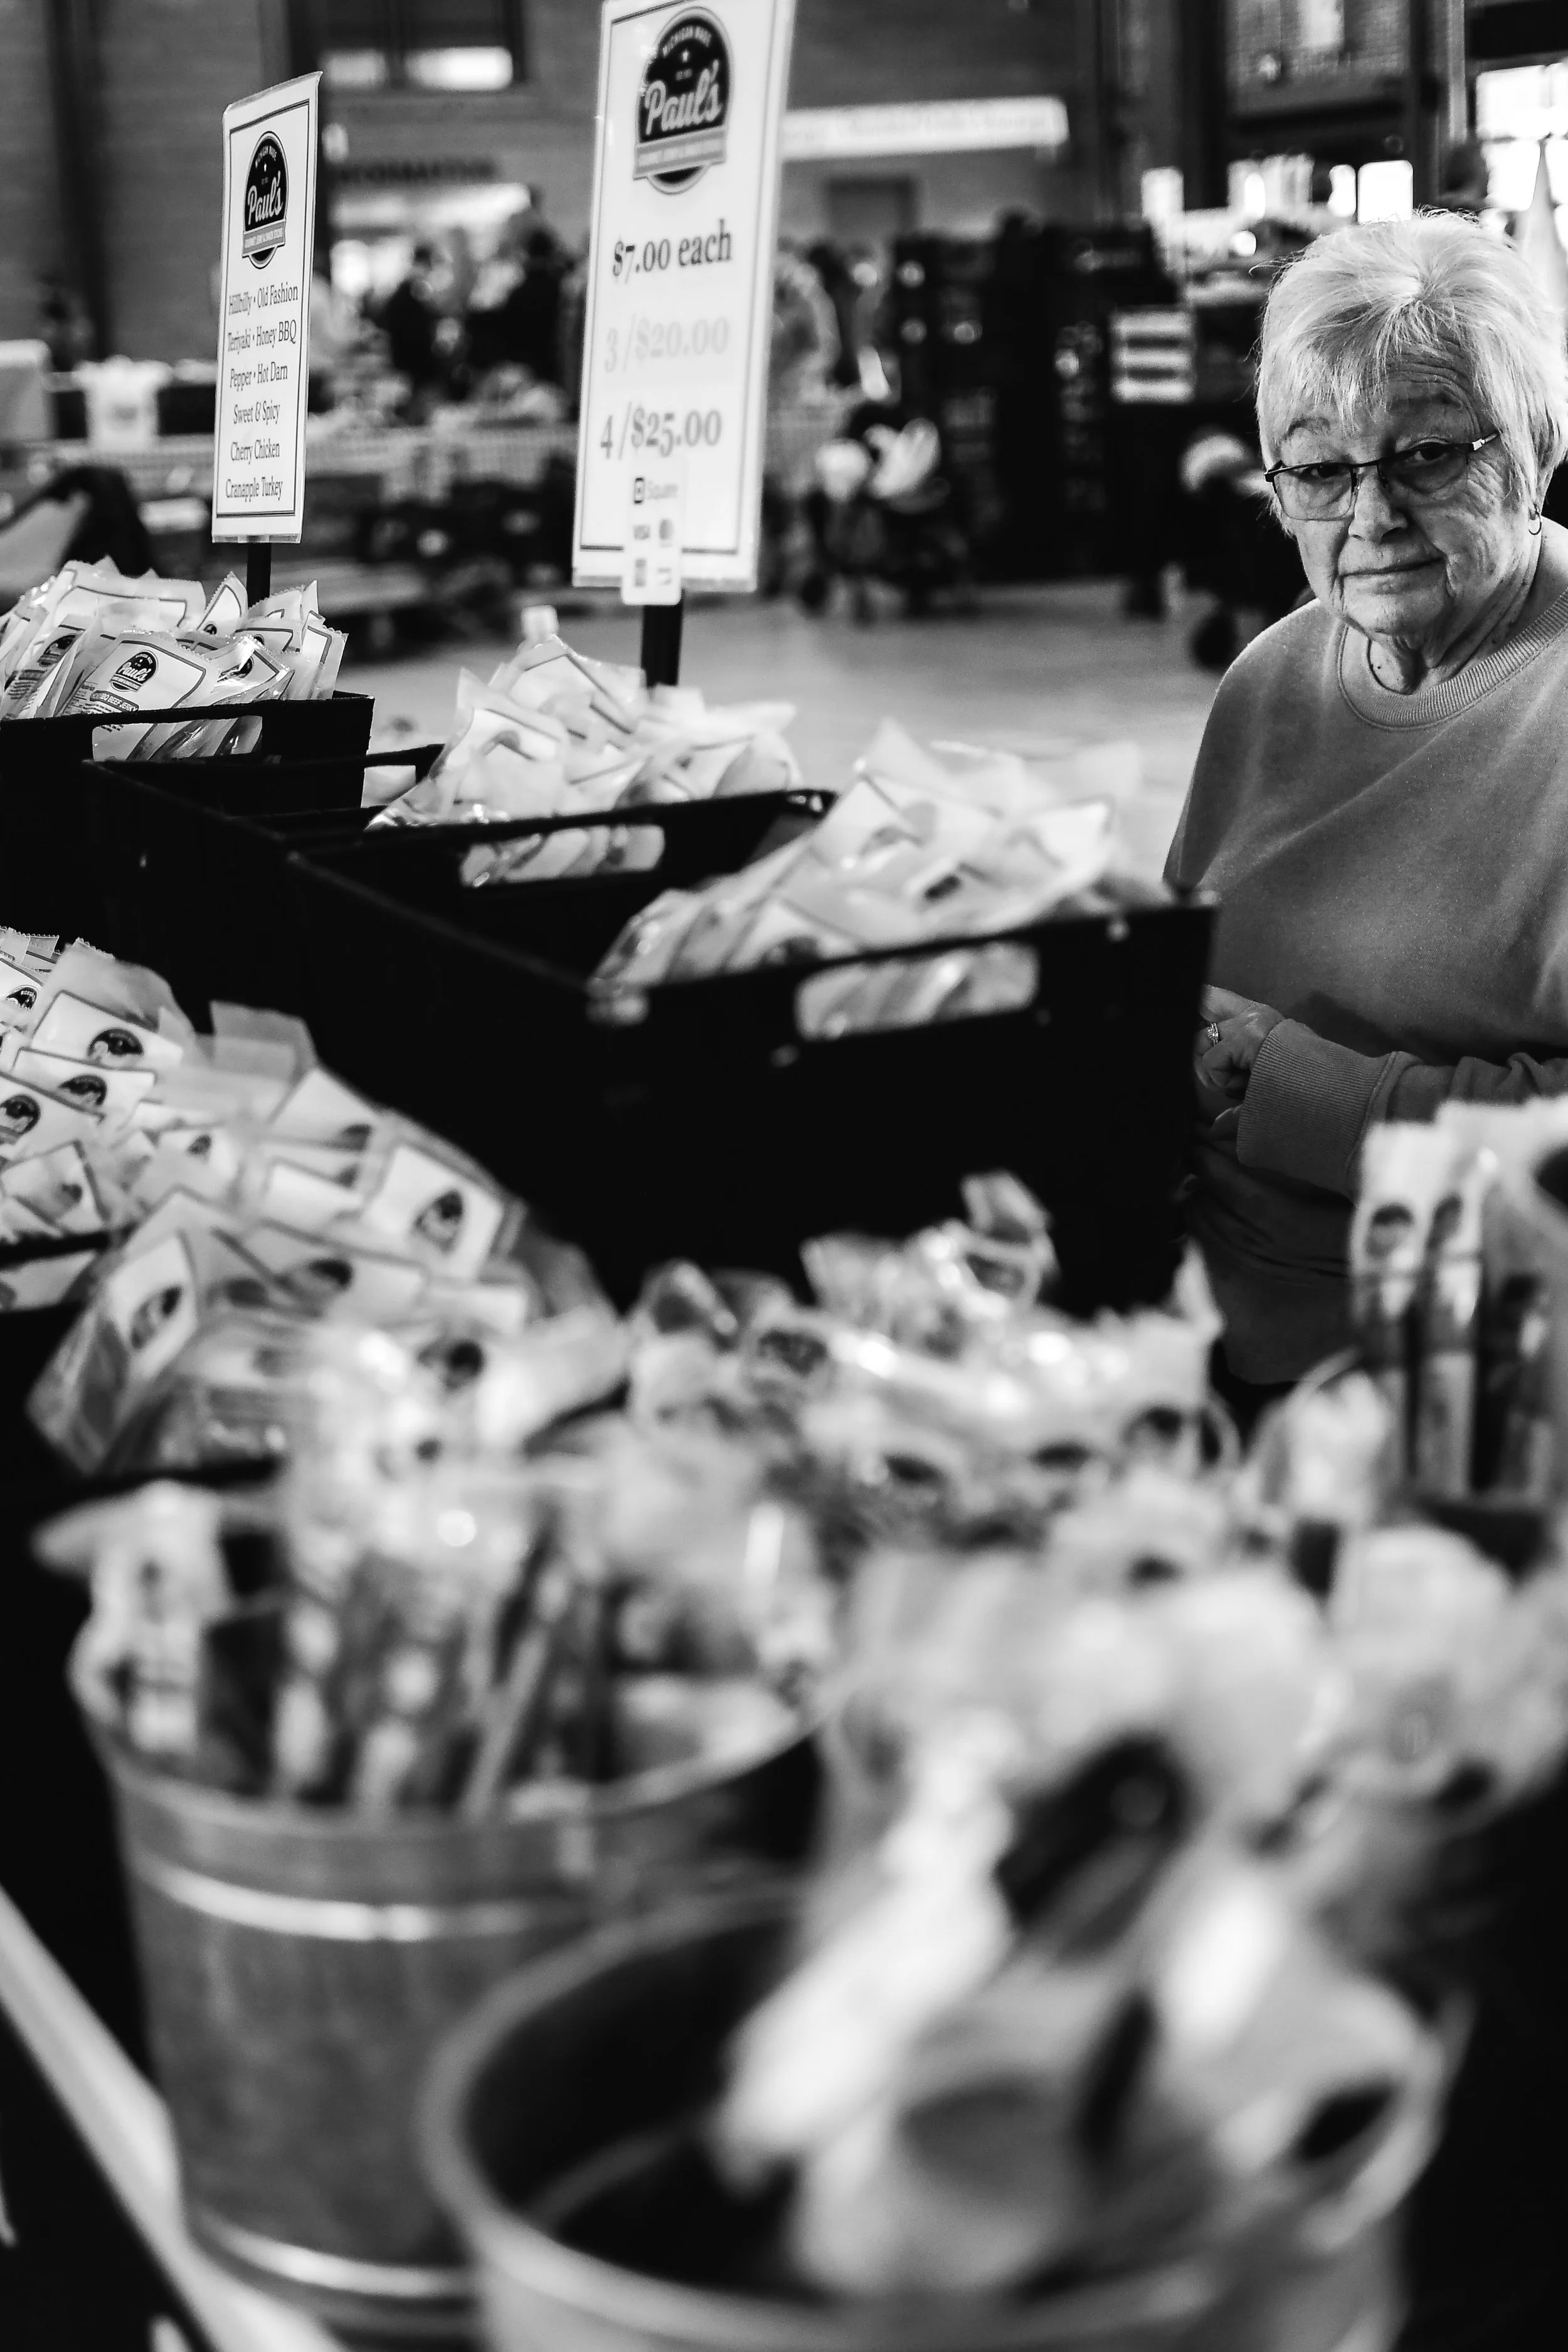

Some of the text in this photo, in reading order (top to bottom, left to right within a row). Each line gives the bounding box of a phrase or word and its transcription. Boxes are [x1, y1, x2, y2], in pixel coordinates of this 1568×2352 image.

[645, 59, 723, 136] Paul's
[247, 170, 283, 226] Paul's
[612, 218, 732, 283] $7.00 each
[257, 286, 268, 308] Old
[270, 281, 299, 305] Fashion
[256, 326, 277, 349] Honey
[278, 319, 297, 345] BBQ
[604, 314, 729, 373] 3/$20.00
[230, 368, 252, 392] Pepper
[257, 363, 269, 384] Hot
[233, 404, 253, 424] Sweet
[262, 400, 280, 426] Spicy
[600, 401, 722, 461] 4/$25.00
[231, 438, 280, 465] Cherry Chicken
[261, 475, 283, 501] Turkey
[117, 661, 152, 682] Paul's
[107, 696, 123, 706] BEEF
